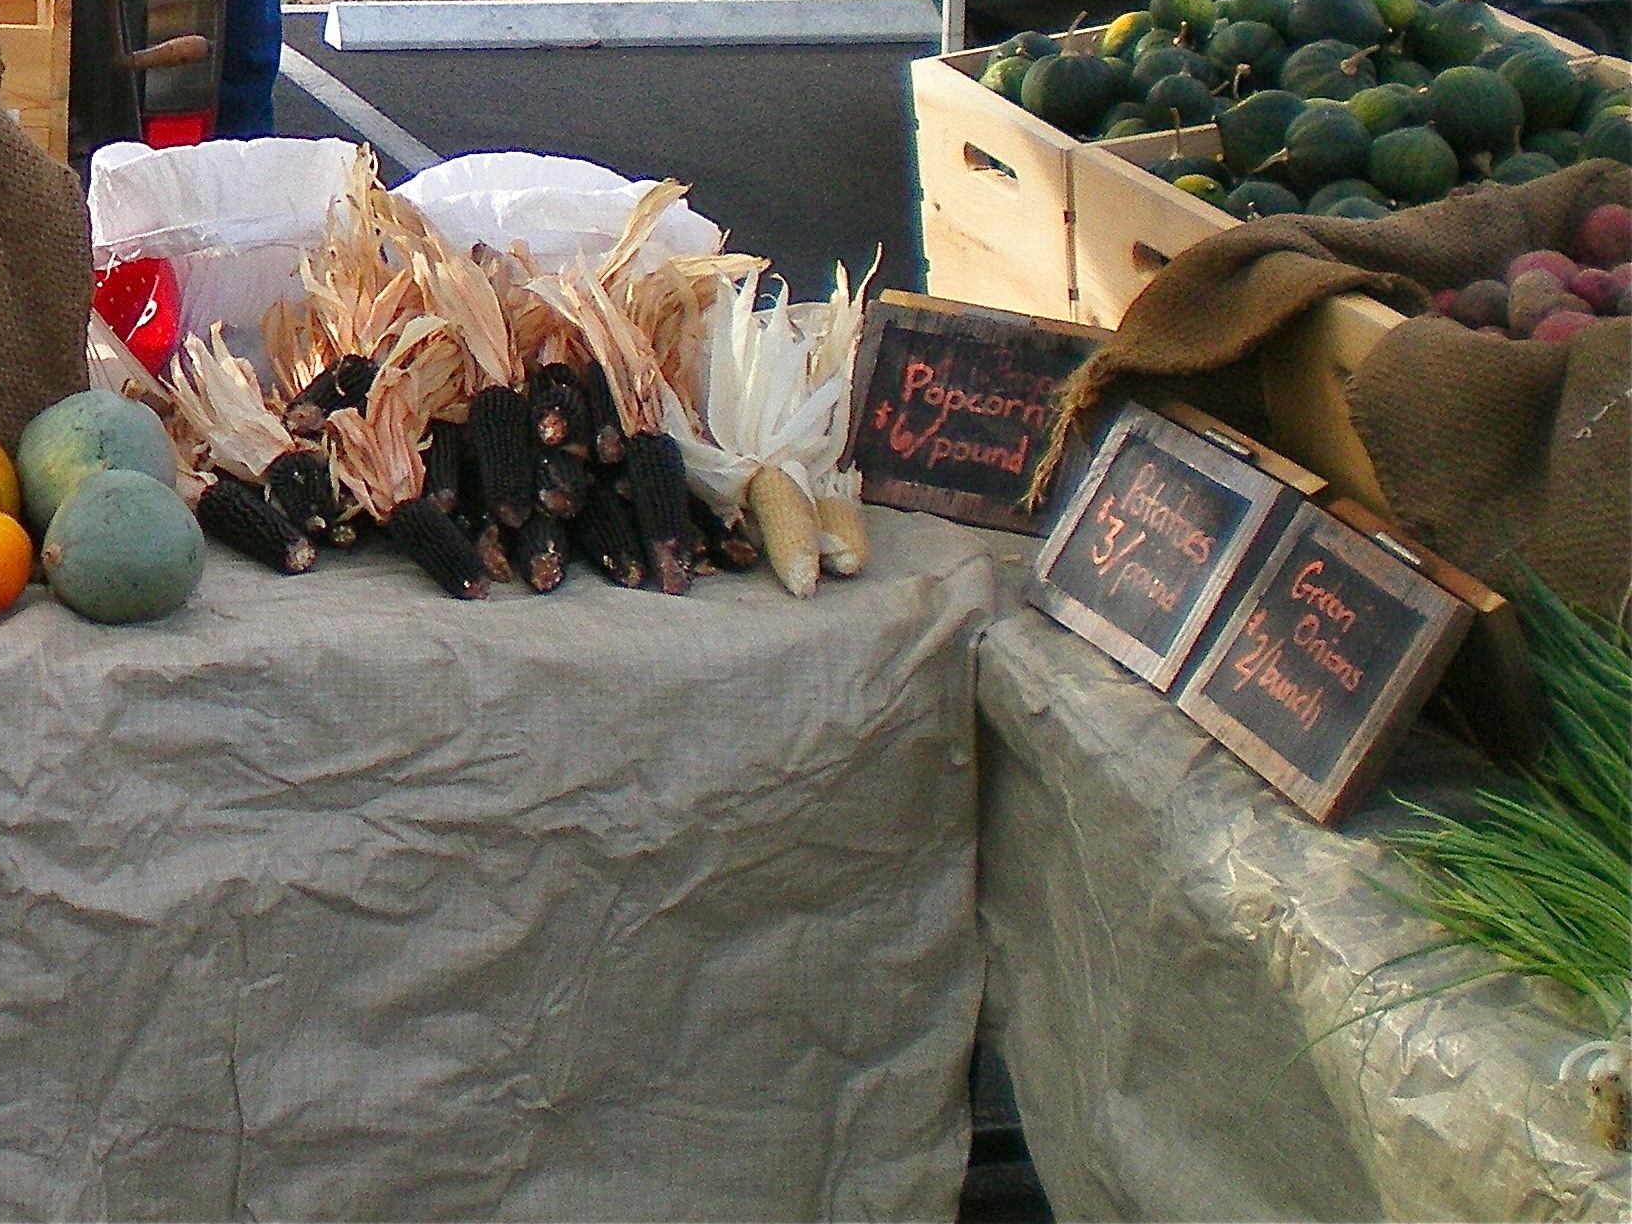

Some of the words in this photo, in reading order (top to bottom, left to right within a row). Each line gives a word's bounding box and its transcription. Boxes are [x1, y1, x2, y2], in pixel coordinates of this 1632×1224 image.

[901, 358, 1046, 426] Popcorn
[1120, 461, 1217, 566] Potatoes
[1291, 560, 1357, 634] Green
[1292, 612, 1365, 693] Onions
